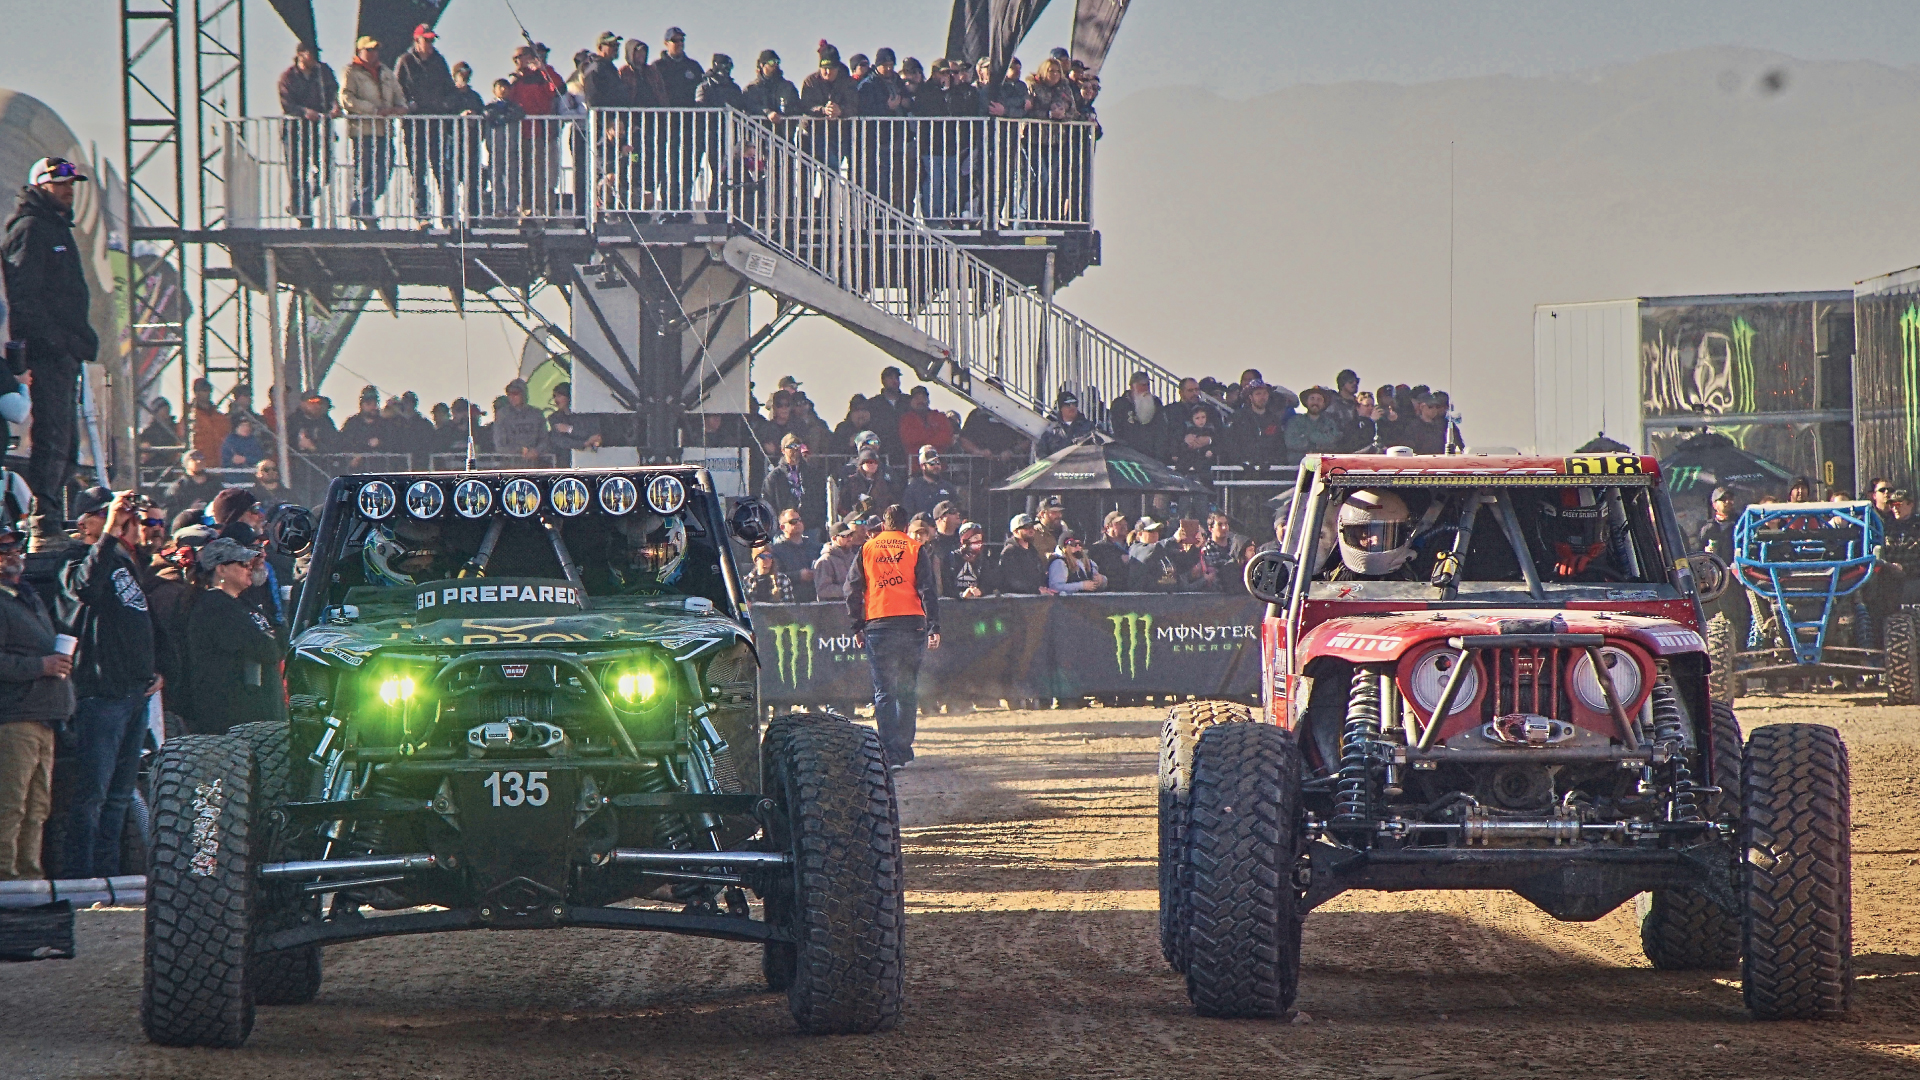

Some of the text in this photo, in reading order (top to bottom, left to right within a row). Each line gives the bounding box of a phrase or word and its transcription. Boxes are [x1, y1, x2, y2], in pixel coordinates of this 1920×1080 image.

[417, 585, 575, 610] GO PREPARED
[1156, 623, 1257, 642] MONSTER
[1326, 632, 1403, 652] NITTO
[1173, 643, 1243, 652] ENERGY
[484, 771, 550, 807] 135
